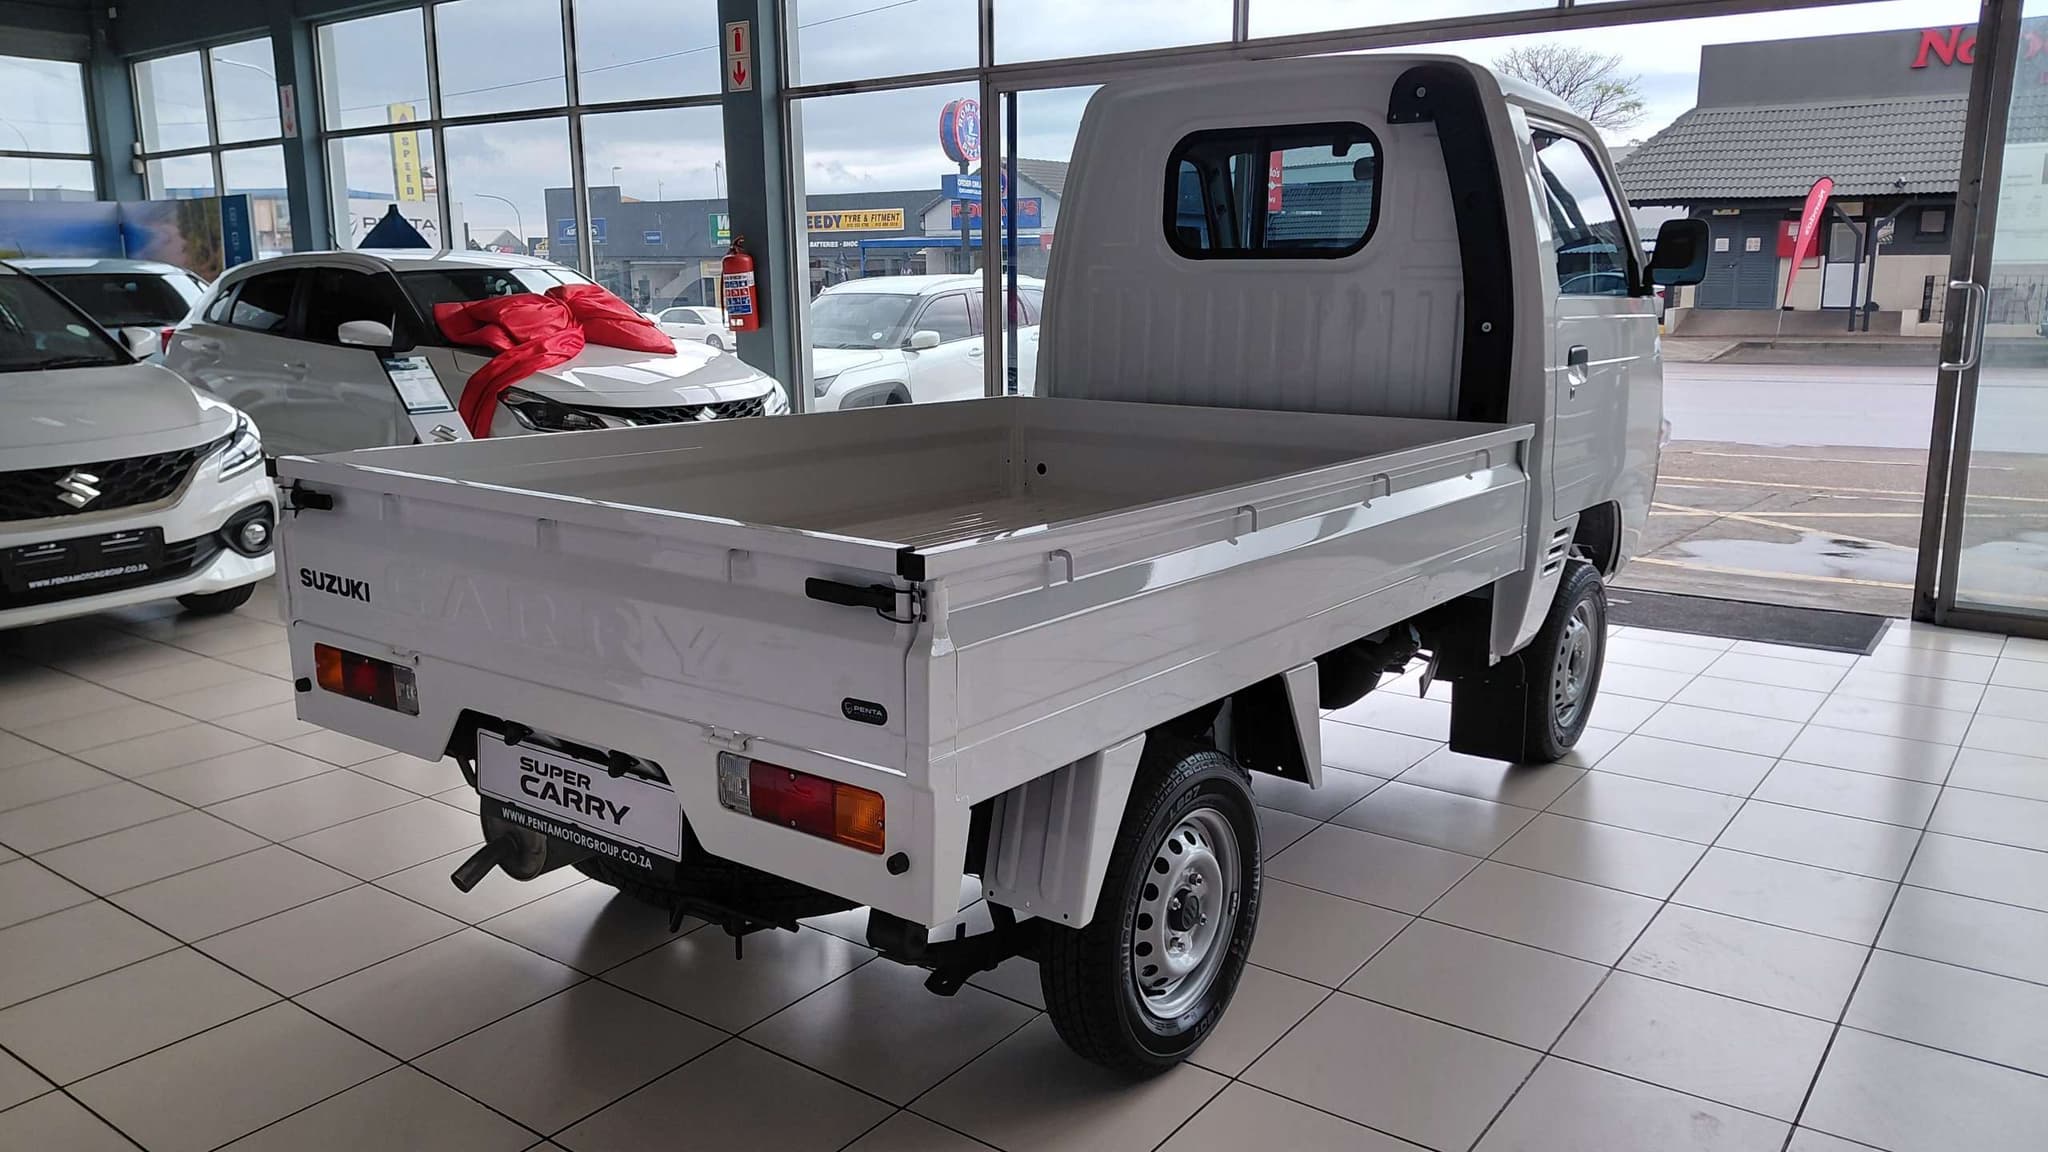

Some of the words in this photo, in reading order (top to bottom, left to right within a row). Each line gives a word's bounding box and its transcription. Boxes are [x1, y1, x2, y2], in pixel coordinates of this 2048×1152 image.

[400, 136, 416, 202] SPEED
[806, 214, 841, 230] EEDY
[844, 214, 861, 223] TYRE
[870, 212, 900, 222] FITMENT
[300, 567, 371, 603] SUZUKI
[853, 705, 882, 717] PENTA
[520, 756, 591, 791] SUPER
[520, 774, 631, 826] CARRY
[501, 806, 653, 871] WWW.PENTAMOTORGROUP.CO.ZA
